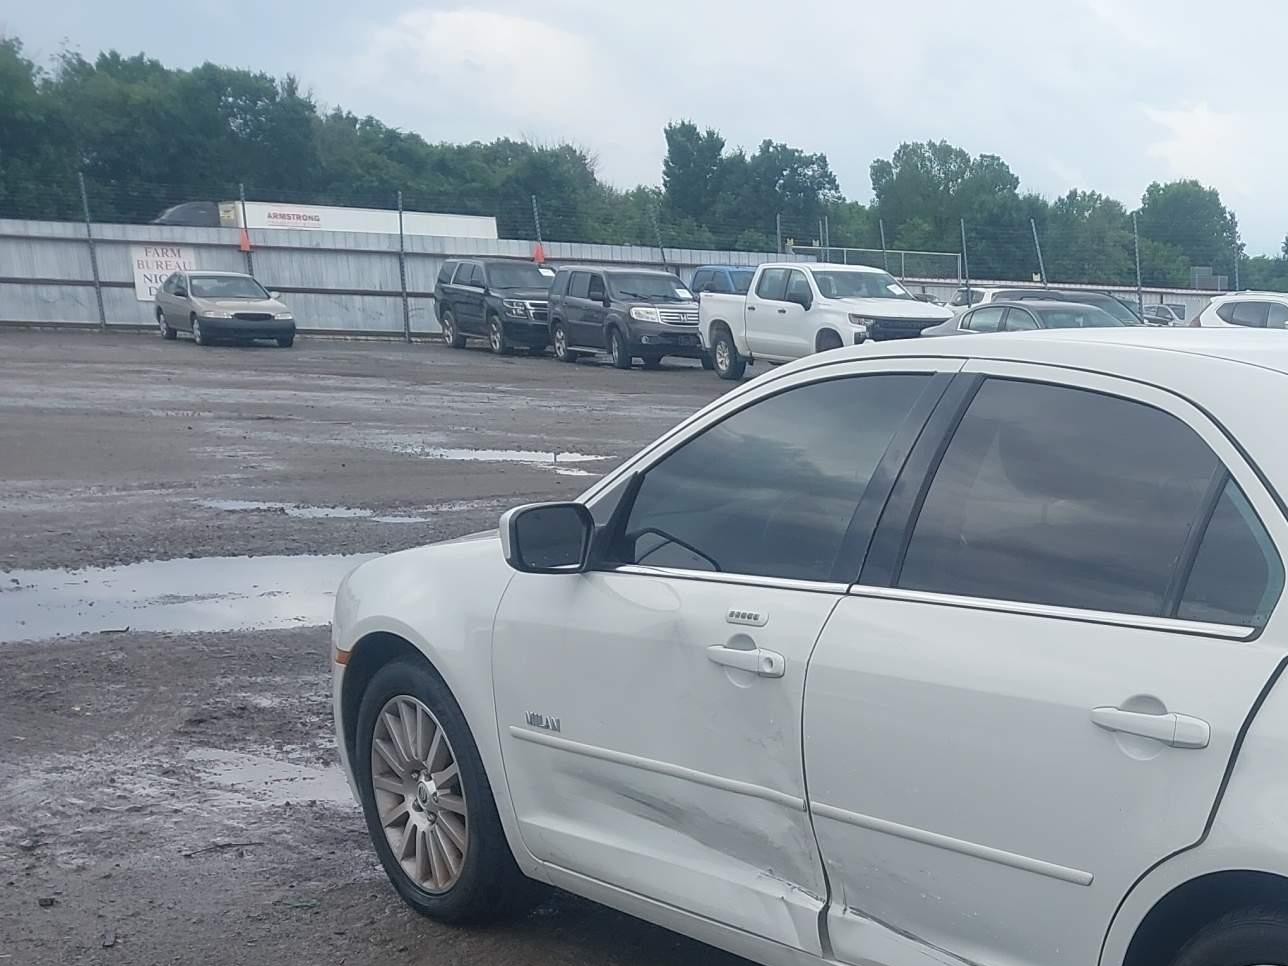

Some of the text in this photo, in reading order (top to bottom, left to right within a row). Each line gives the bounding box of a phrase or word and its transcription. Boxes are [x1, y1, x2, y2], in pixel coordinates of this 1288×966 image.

[267, 212, 320, 222] ARMSTRONG
[144, 247, 182, 258] FARM
[137, 259, 192, 272] BUREAU
